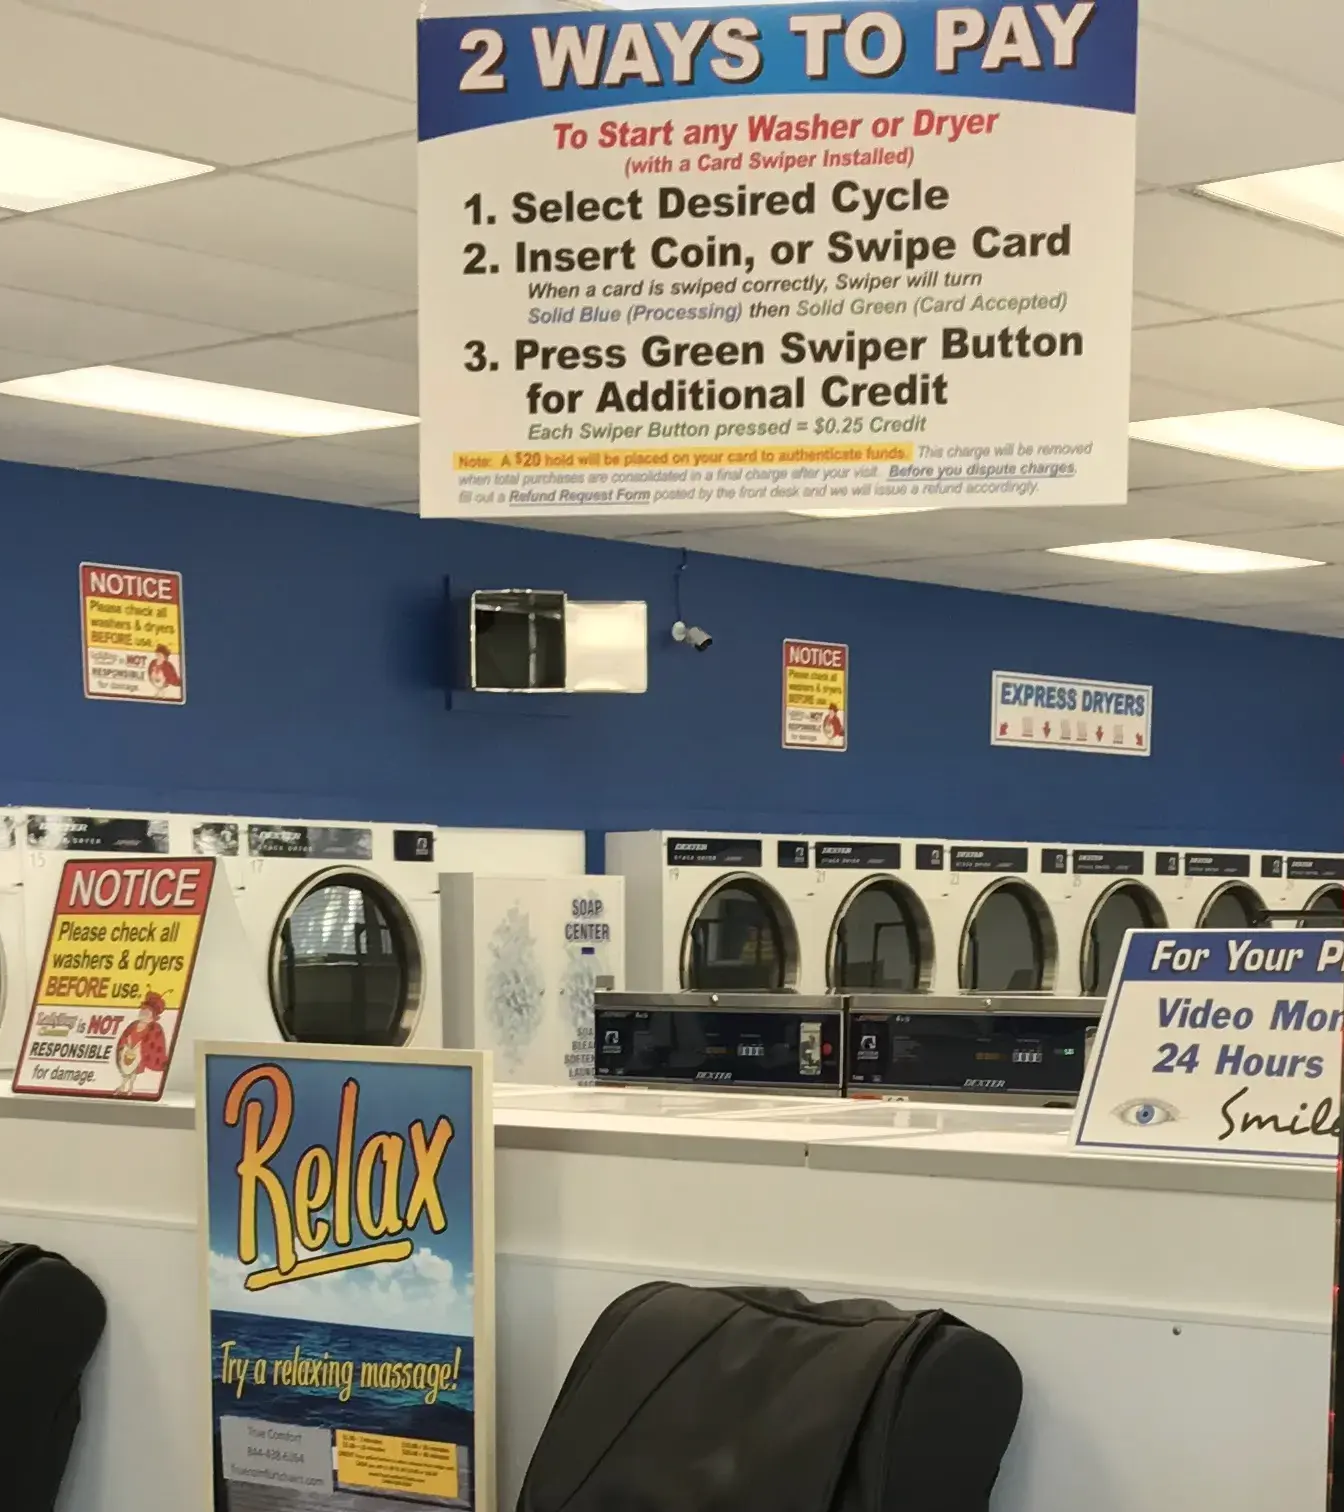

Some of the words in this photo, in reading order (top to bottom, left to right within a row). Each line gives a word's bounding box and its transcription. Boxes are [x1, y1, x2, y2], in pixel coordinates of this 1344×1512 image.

[458, 29, 507, 93] 2
[533, 17, 759, 89] WAYS
[790, 13, 906, 80] TO
[935, 2, 1096, 72] PAY
[553, 124, 587, 150] To
[598, 122, 674, 148] Start
[684, 121, 737, 151] any
[748, 114, 862, 144] Washer
[872, 115, 904, 139] or
[913, 109, 999, 143] Dryer
[624, 156, 673, 178] (with
[679, 159, 691, 173] a
[697, 152, 743, 173] Card
[750, 151, 817, 175] Swiper
[822, 146, 915, 170] Installed)
[464, 195, 496, 226] 1.
[512, 190, 643, 224] Select
[658, 182, 815, 220] Desired
[831, 179, 950, 219] Cycle
[463, 242, 501, 276] 2.
[516, 239, 635, 274] Insert
[650, 236, 756, 271] Coin,
[770, 238, 814, 266] or
[827, 230, 957, 268] Swipe
[972, 224, 1072, 259] Card
[527, 280, 578, 300] When
[584, 284, 597, 298] a
[601, 279, 645, 299] card
[650, 278, 664, 296] is
[670, 274, 735, 299] swiped
[742, 273, 828, 297] correctly,
[835, 271, 899, 295] Swiper
[905, 271, 937, 289] will
[944, 271, 983, 288] turn
[527, 305, 573, 325] Solid
[579, 304, 620, 324] Blue
[625, 302, 742, 326] (Processing)
[749, 300, 790, 319] then
[796, 299, 841, 318] Solid
[848, 296, 907, 316] Green
[913, 295, 968, 317] (Card
[972, 291, 1068, 314] Accepted)
[464, 341, 499, 373] 3.
[516, 338, 626, 371] Press
[642, 334, 764, 368] Green
[781, 330, 926, 368] Swiper
[942, 327, 1084, 361] Button
[527, 381, 582, 416] for
[596, 378, 806, 412] Additional
[820, 374, 949, 407] Credit
[527, 422, 575, 441] Each
[580, 422, 642, 444] Swiper
[648, 420, 708, 439] Button
[714, 418, 791, 441] pressed
[814, 416, 863, 436] $0.25
[869, 414, 926, 433] Credit
[458, 456, 492, 469] Note:
[501, 455, 510, 466] A
[515, 452, 540, 466] $20
[544, 454, 573, 467] hold
[577, 454, 600, 466] will
[604, 453, 621, 466] be
[624, 452, 669, 466] placed
[672, 453, 690, 465] on
[693, 453, 724, 468] your
[727, 450, 757, 463] card
[761, 450, 776, 463] to
[777, 448, 863, 462] authenticate
[866, 446, 907, 460] funds.
[889, 464, 933, 478] Before
[936, 465, 962, 479] you
[966, 463, 1017, 479] dispute
[509, 490, 555, 503] Refund
[559, 489, 614, 504] Request
[616, 488, 650, 501] Form
[90, 572, 173, 600] NOTICE
[789, 646, 841, 667] NOTICE
[1001, 682, 1076, 711] EXPRESS
[1082, 689, 1145, 717] DRYERS
[29, 851, 47, 868] 15
[68, 868, 201, 907] NOTICE
[572, 899, 604, 916] SOAP
[58, 921, 107, 942] Please
[110, 924, 156, 943] check
[160, 921, 180, 942] all
[565, 924, 610, 941] CENTER
[52, 951, 113, 970] washers
[118, 949, 129, 970] &
[134, 951, 184, 976] dryers
[1150, 939, 1211, 972] For
[1227, 939, 1304, 972] Your
[44, 976, 111, 998] BEFORE
[112, 982, 141, 999] use.
[77, 1018, 86, 1033] is
[87, 1015, 125, 1036] NOT
[1158, 997, 1254, 1030] Video
[29, 1042, 113, 1060] RESPONSIBLE
[1151, 1042, 1200, 1074] 24
[1214, 1044, 1324, 1079] Hours
[32, 1065, 49, 1080] for
[50, 1065, 96, 1086] damage.
[695, 1071, 732, 1081] DEXTER
[963, 1078, 1006, 1089] DEXTER
[223, 1062, 455, 1276] Relax
[220, 1340, 248, 1400] Try
[254, 1364, 266, 1385] a
[273, 1344, 354, 1402] relaxing
[360, 1346, 462, 1404] massage!
